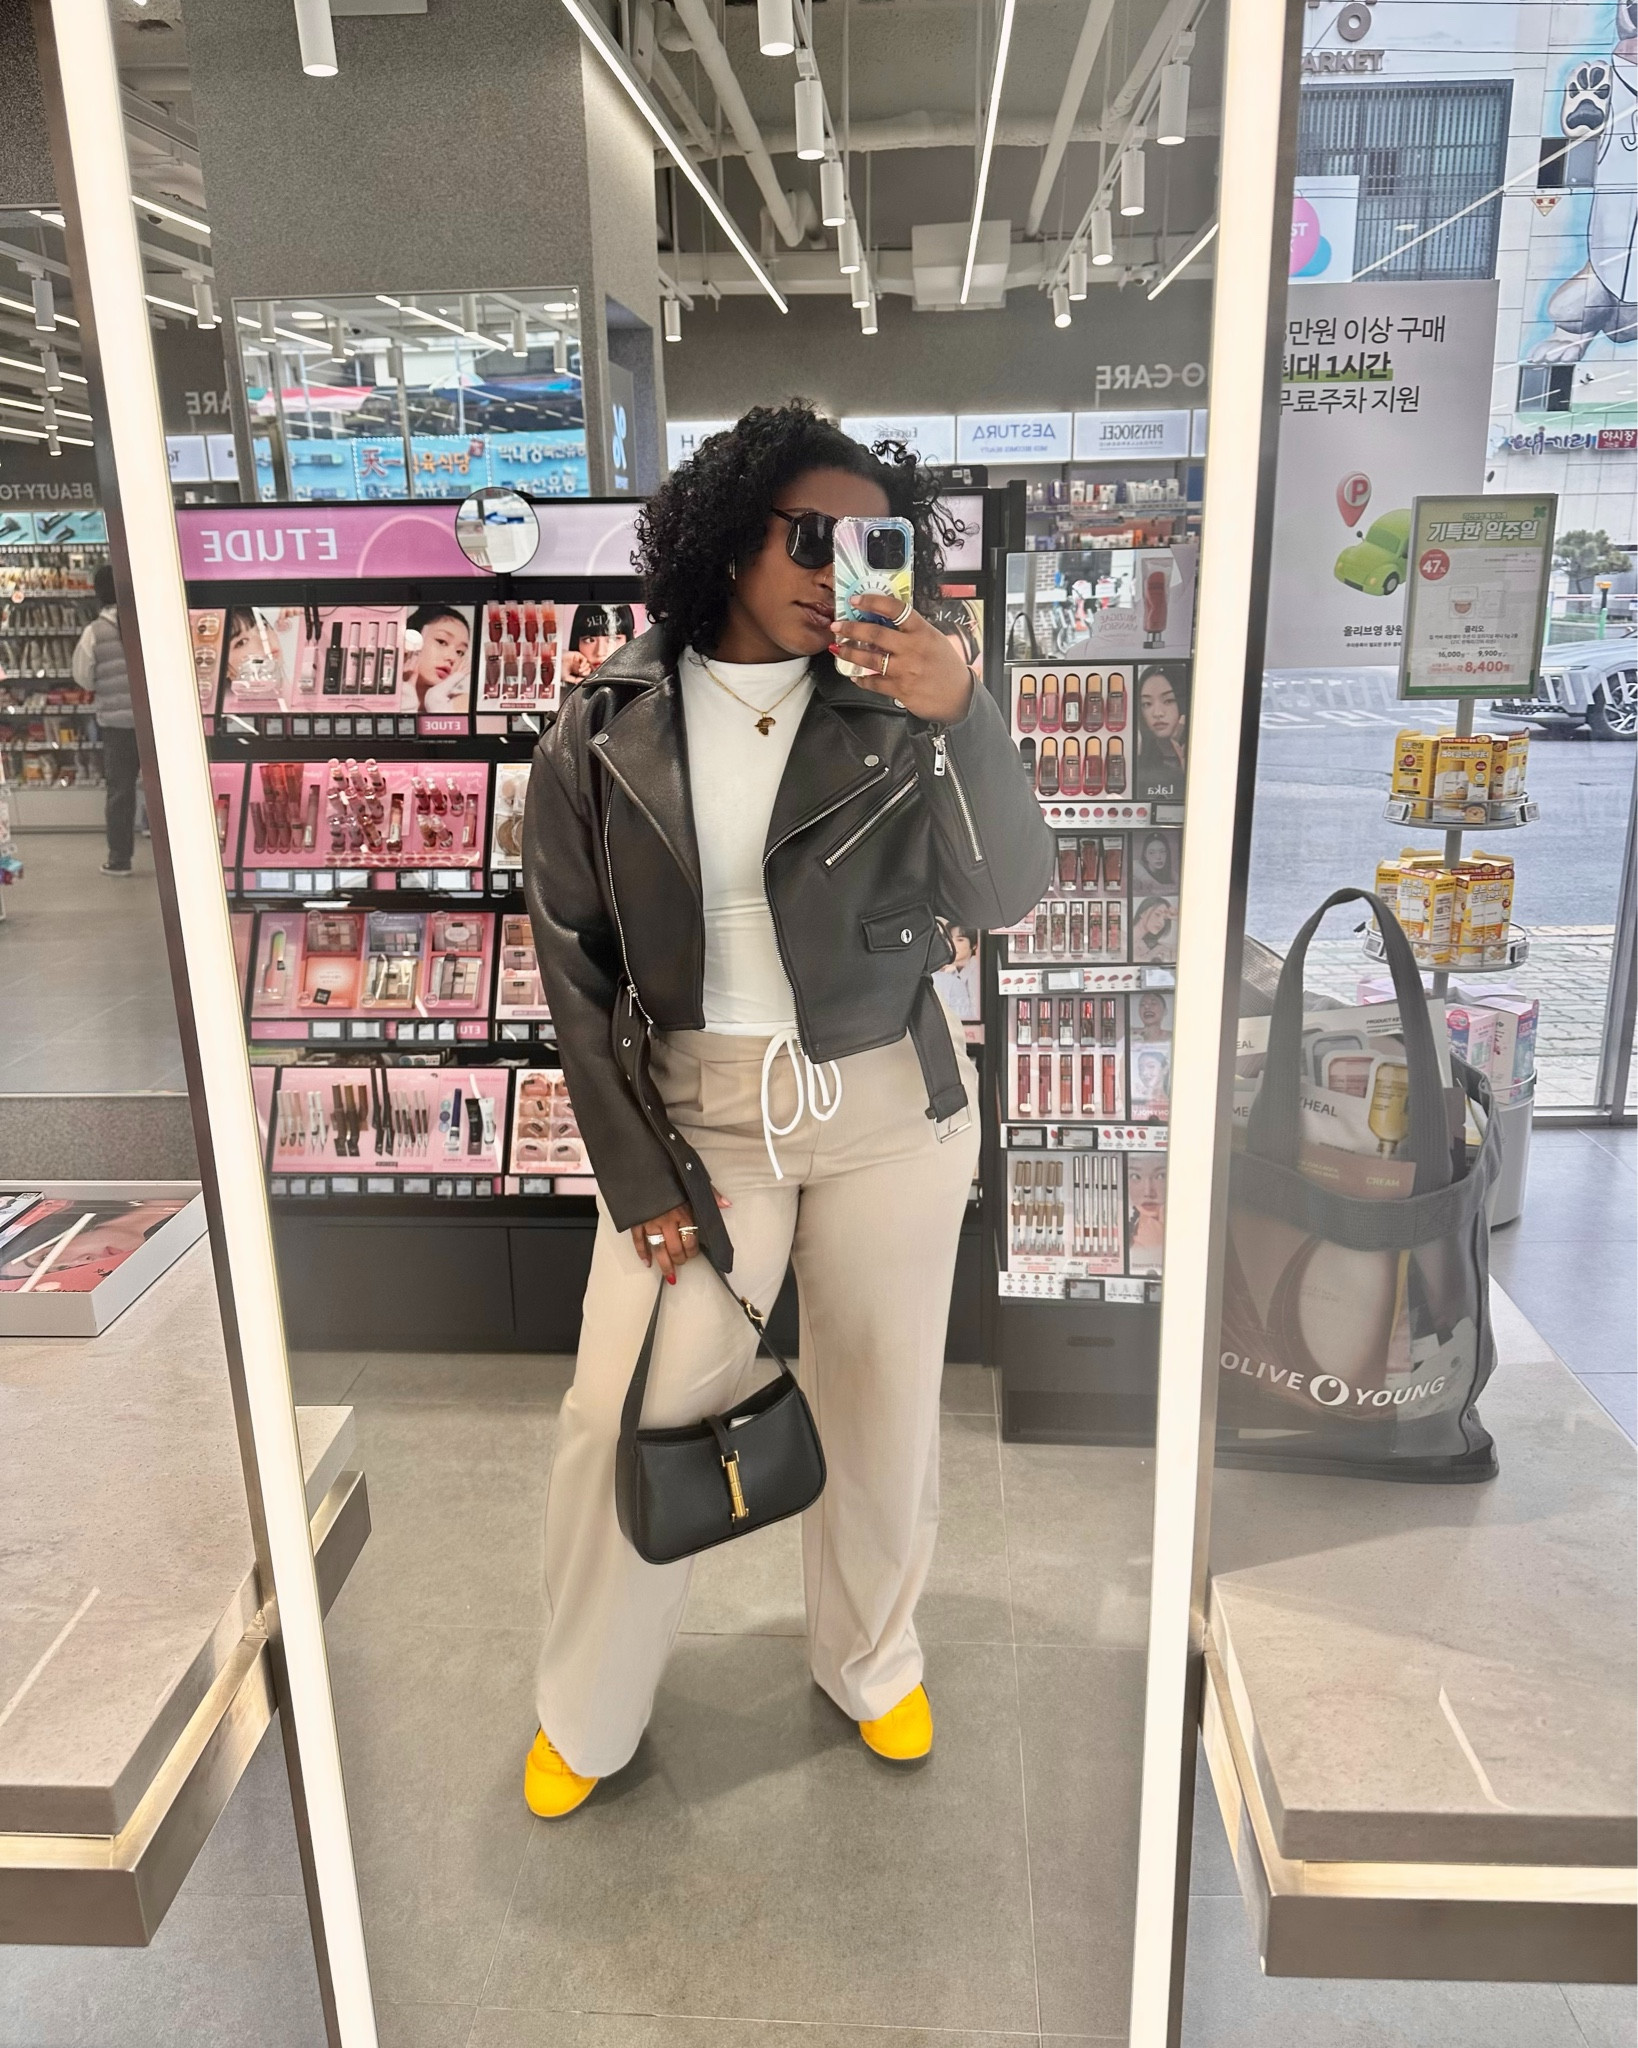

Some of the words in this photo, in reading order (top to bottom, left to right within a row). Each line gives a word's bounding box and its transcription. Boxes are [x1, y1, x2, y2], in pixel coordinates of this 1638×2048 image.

[1284, 317, 1337, 346] 만원
[1344, 316, 1393, 344] 이상
[1397, 315, 1446, 343] 구매
[1325, 351, 1391, 379] 1시간
[1371, 385, 1420, 413] 지원
[1427, 521, 1482, 542] 기특한
[1485, 519, 1540, 541] 일주일
[1343, 625, 1382, 637] 올리브영
[1220, 1351, 1305, 1390] OLIVE
[1355, 1375, 1446, 1407] YOUNG
